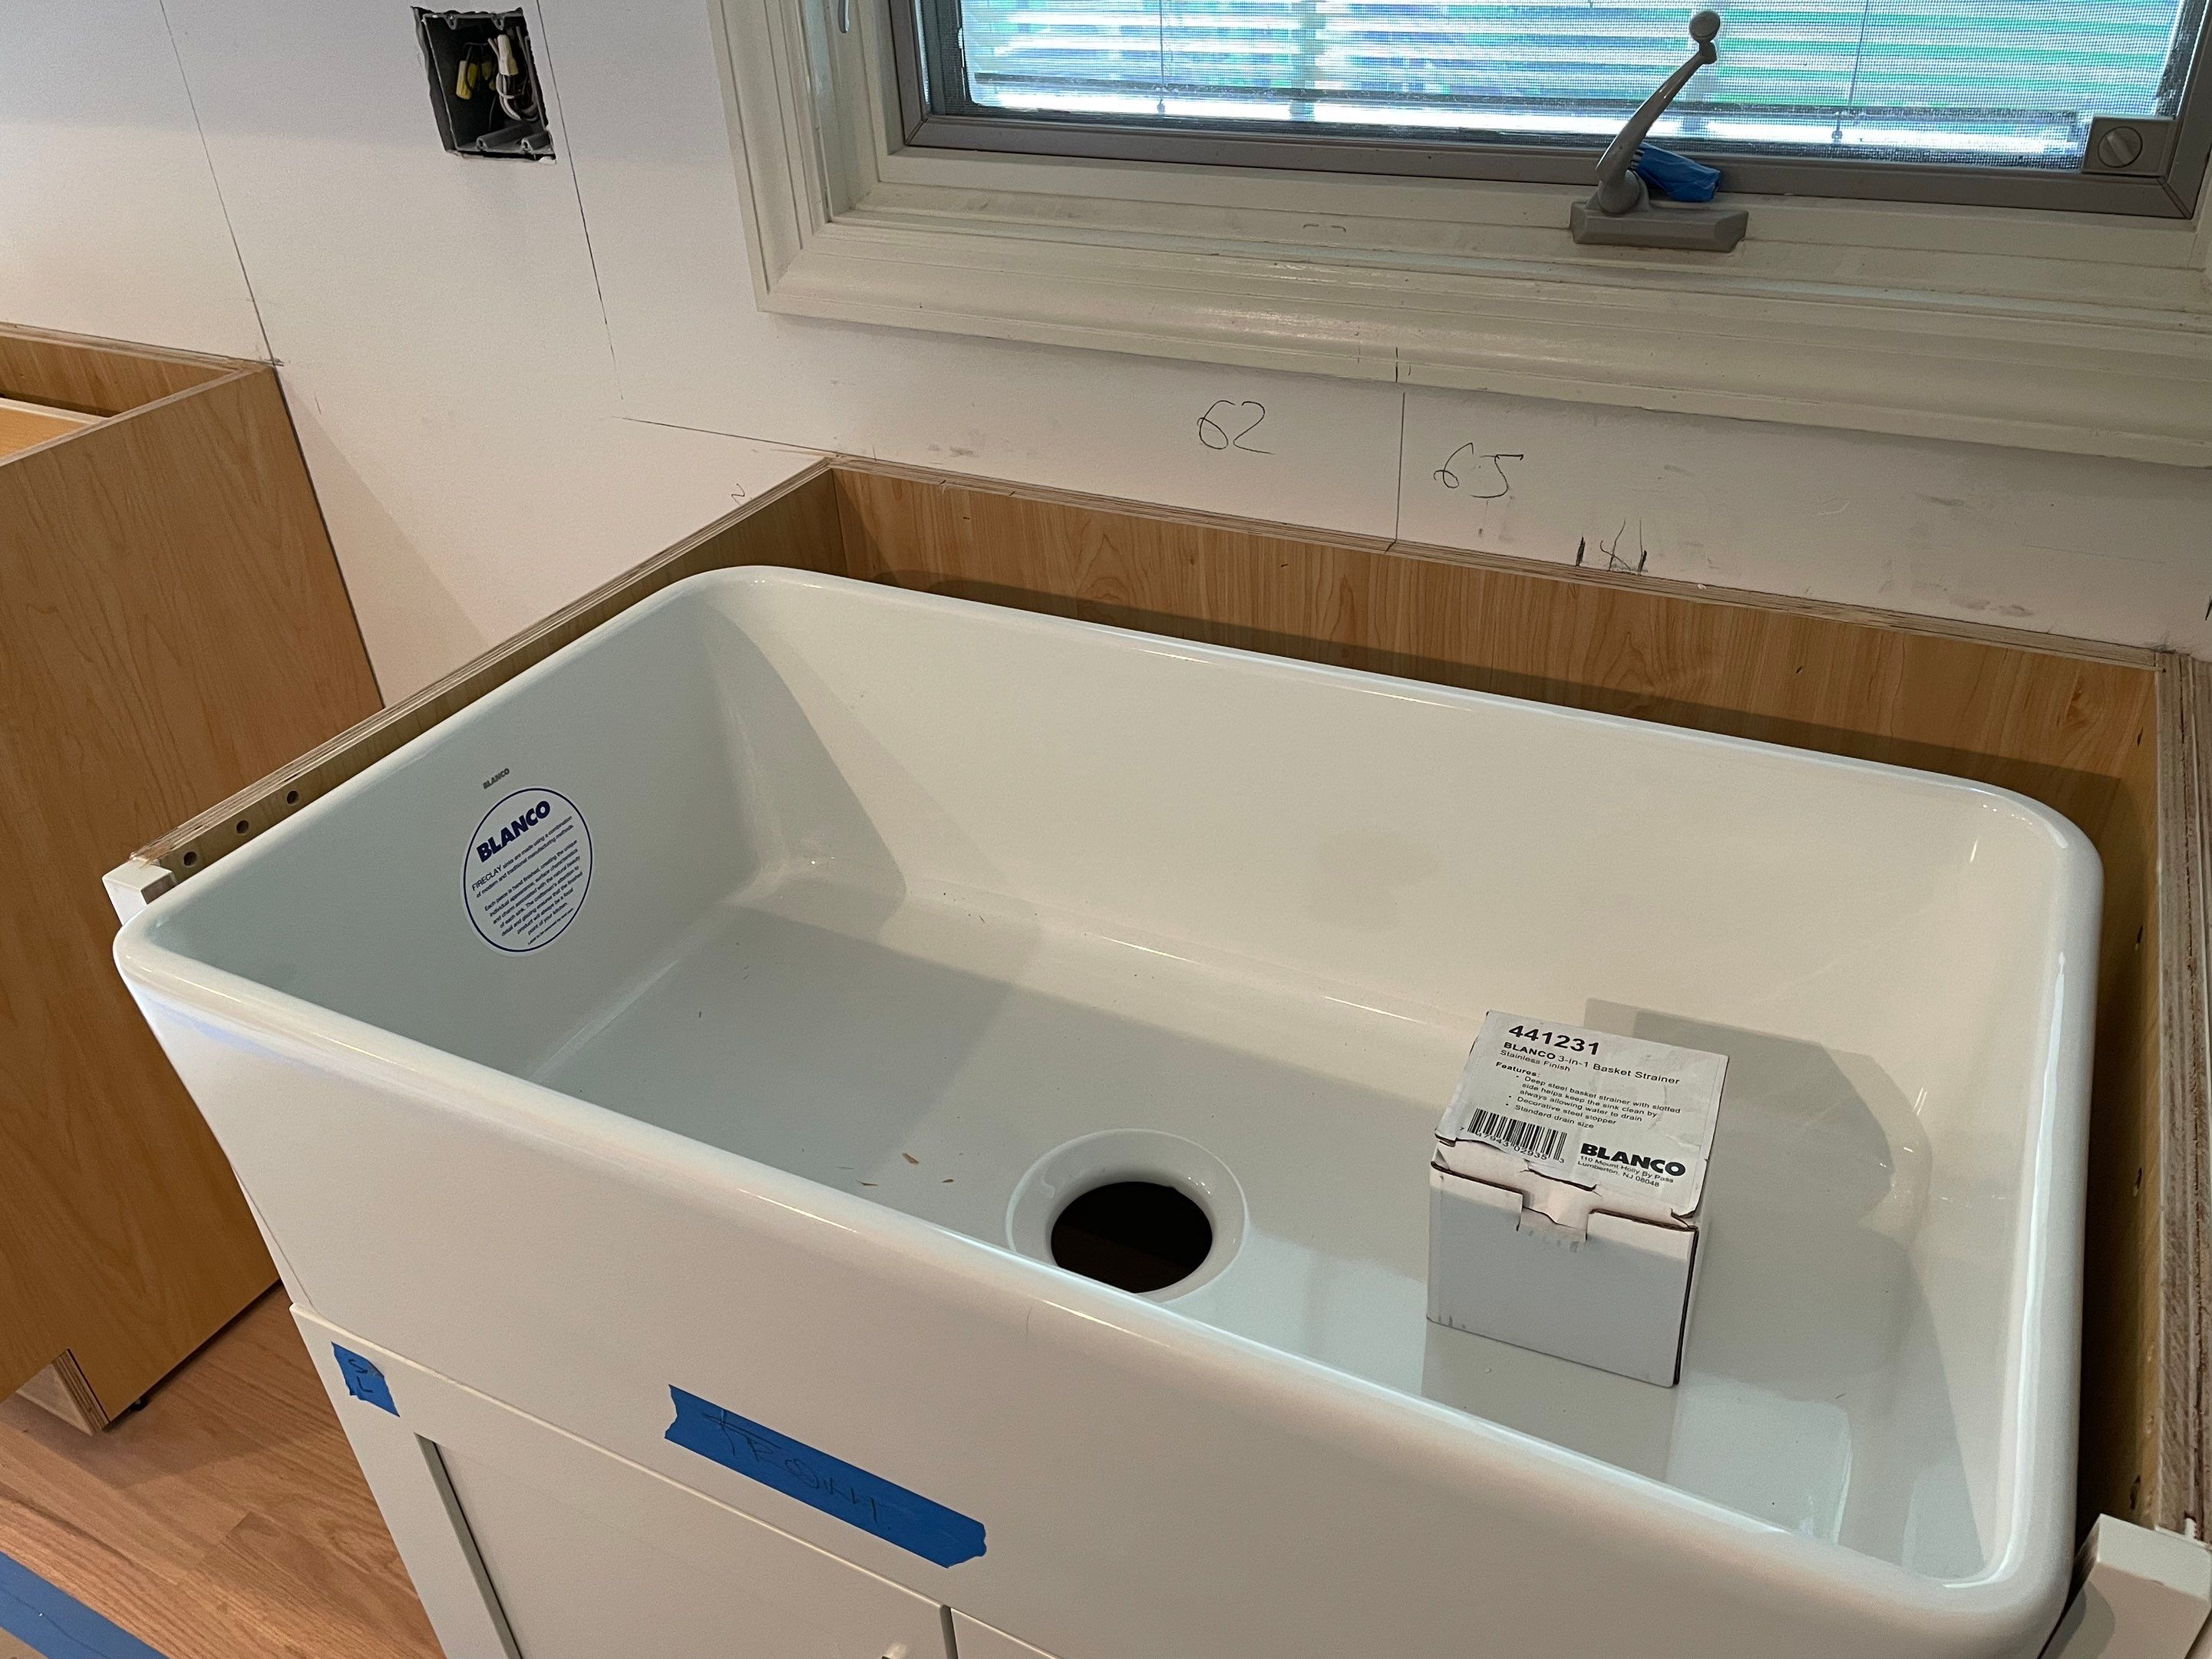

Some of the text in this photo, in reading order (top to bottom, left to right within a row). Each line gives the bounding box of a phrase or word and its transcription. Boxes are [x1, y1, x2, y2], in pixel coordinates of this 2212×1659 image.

[1197, 400, 1275, 455] 62
[483, 768, 510, 790] BLANCO
[476, 800, 551, 862] BLANCO
[472, 865, 501, 890] FIRECLAY
[482, 880, 499, 894] modern
[499, 872, 507, 882] and
[507, 857, 527, 875] traditional
[528, 837, 556, 859] manufacturing
[485, 901, 497, 911] Each
[512, 879, 523, 890] hand
[541, 855, 557, 869] creating
[564, 839, 577, 851] unique
[536, 869, 550, 882] surface
[494, 915, 502, 924] and
[502, 905, 516, 917] charm
[553, 865, 567, 877] natural
[567, 856, 580, 867] beauty
[505, 914, 516, 924] each
[516, 908, 526, 916] sink.
[558, 869, 575, 884] attention
[502, 925, 513, 936] detail
[523, 908, 537, 921] glazing
[537, 895, 553, 909] ensures
[553, 888, 561, 896] that
[517, 919, 533, 934] product
[564, 887, 574, 897] focal
[528, 924, 539, 935] point
[544, 913, 553, 923] your
[553, 902, 568, 915] kitchen.
[1508, 1025, 1600, 1056] 441231
[1496, 1062, 1540, 1077] Features:
[1501, 1050, 1571, 1072] Stainless Finish
[1504, 1042, 1680, 1085] BLANCO 3-in-1 Basket Strainer
[1517, 1097, 1616, 1126] Decorative steel stopper
[1520, 1090, 1547, 1101] always
[1550, 1097, 1583, 1110] allowing
[1586, 1107, 1608, 1115] water
[1621, 1113, 1642, 1122] drain
[1522, 1083, 1539, 1091] side
[1541, 1087, 1563, 1097] helps
[1566, 1093, 1585, 1103] keep
[1603, 1103, 1619, 1111] sink
[1622, 1106, 1645, 1115] clean
[1524, 1077, 1546, 1088] Deep
[1548, 1082, 1568, 1091] steel
[1570, 1087, 1596, 1100] basket
[1599, 1094, 1630, 1105] strainer
[1652, 1104, 1681, 1114] slotted
[1515, 1105, 1552, 1119] Standard
[1554, 1114, 1575, 1124] drain
[1580, 1143, 1686, 1176] BLANCO
[1595, 1159, 1619, 1169] Mount
[1621, 1165, 1640, 1175] Holly
[1655, 1175, 1674, 1183] Pass
[1636, 1176, 1659, 1187] 08048
